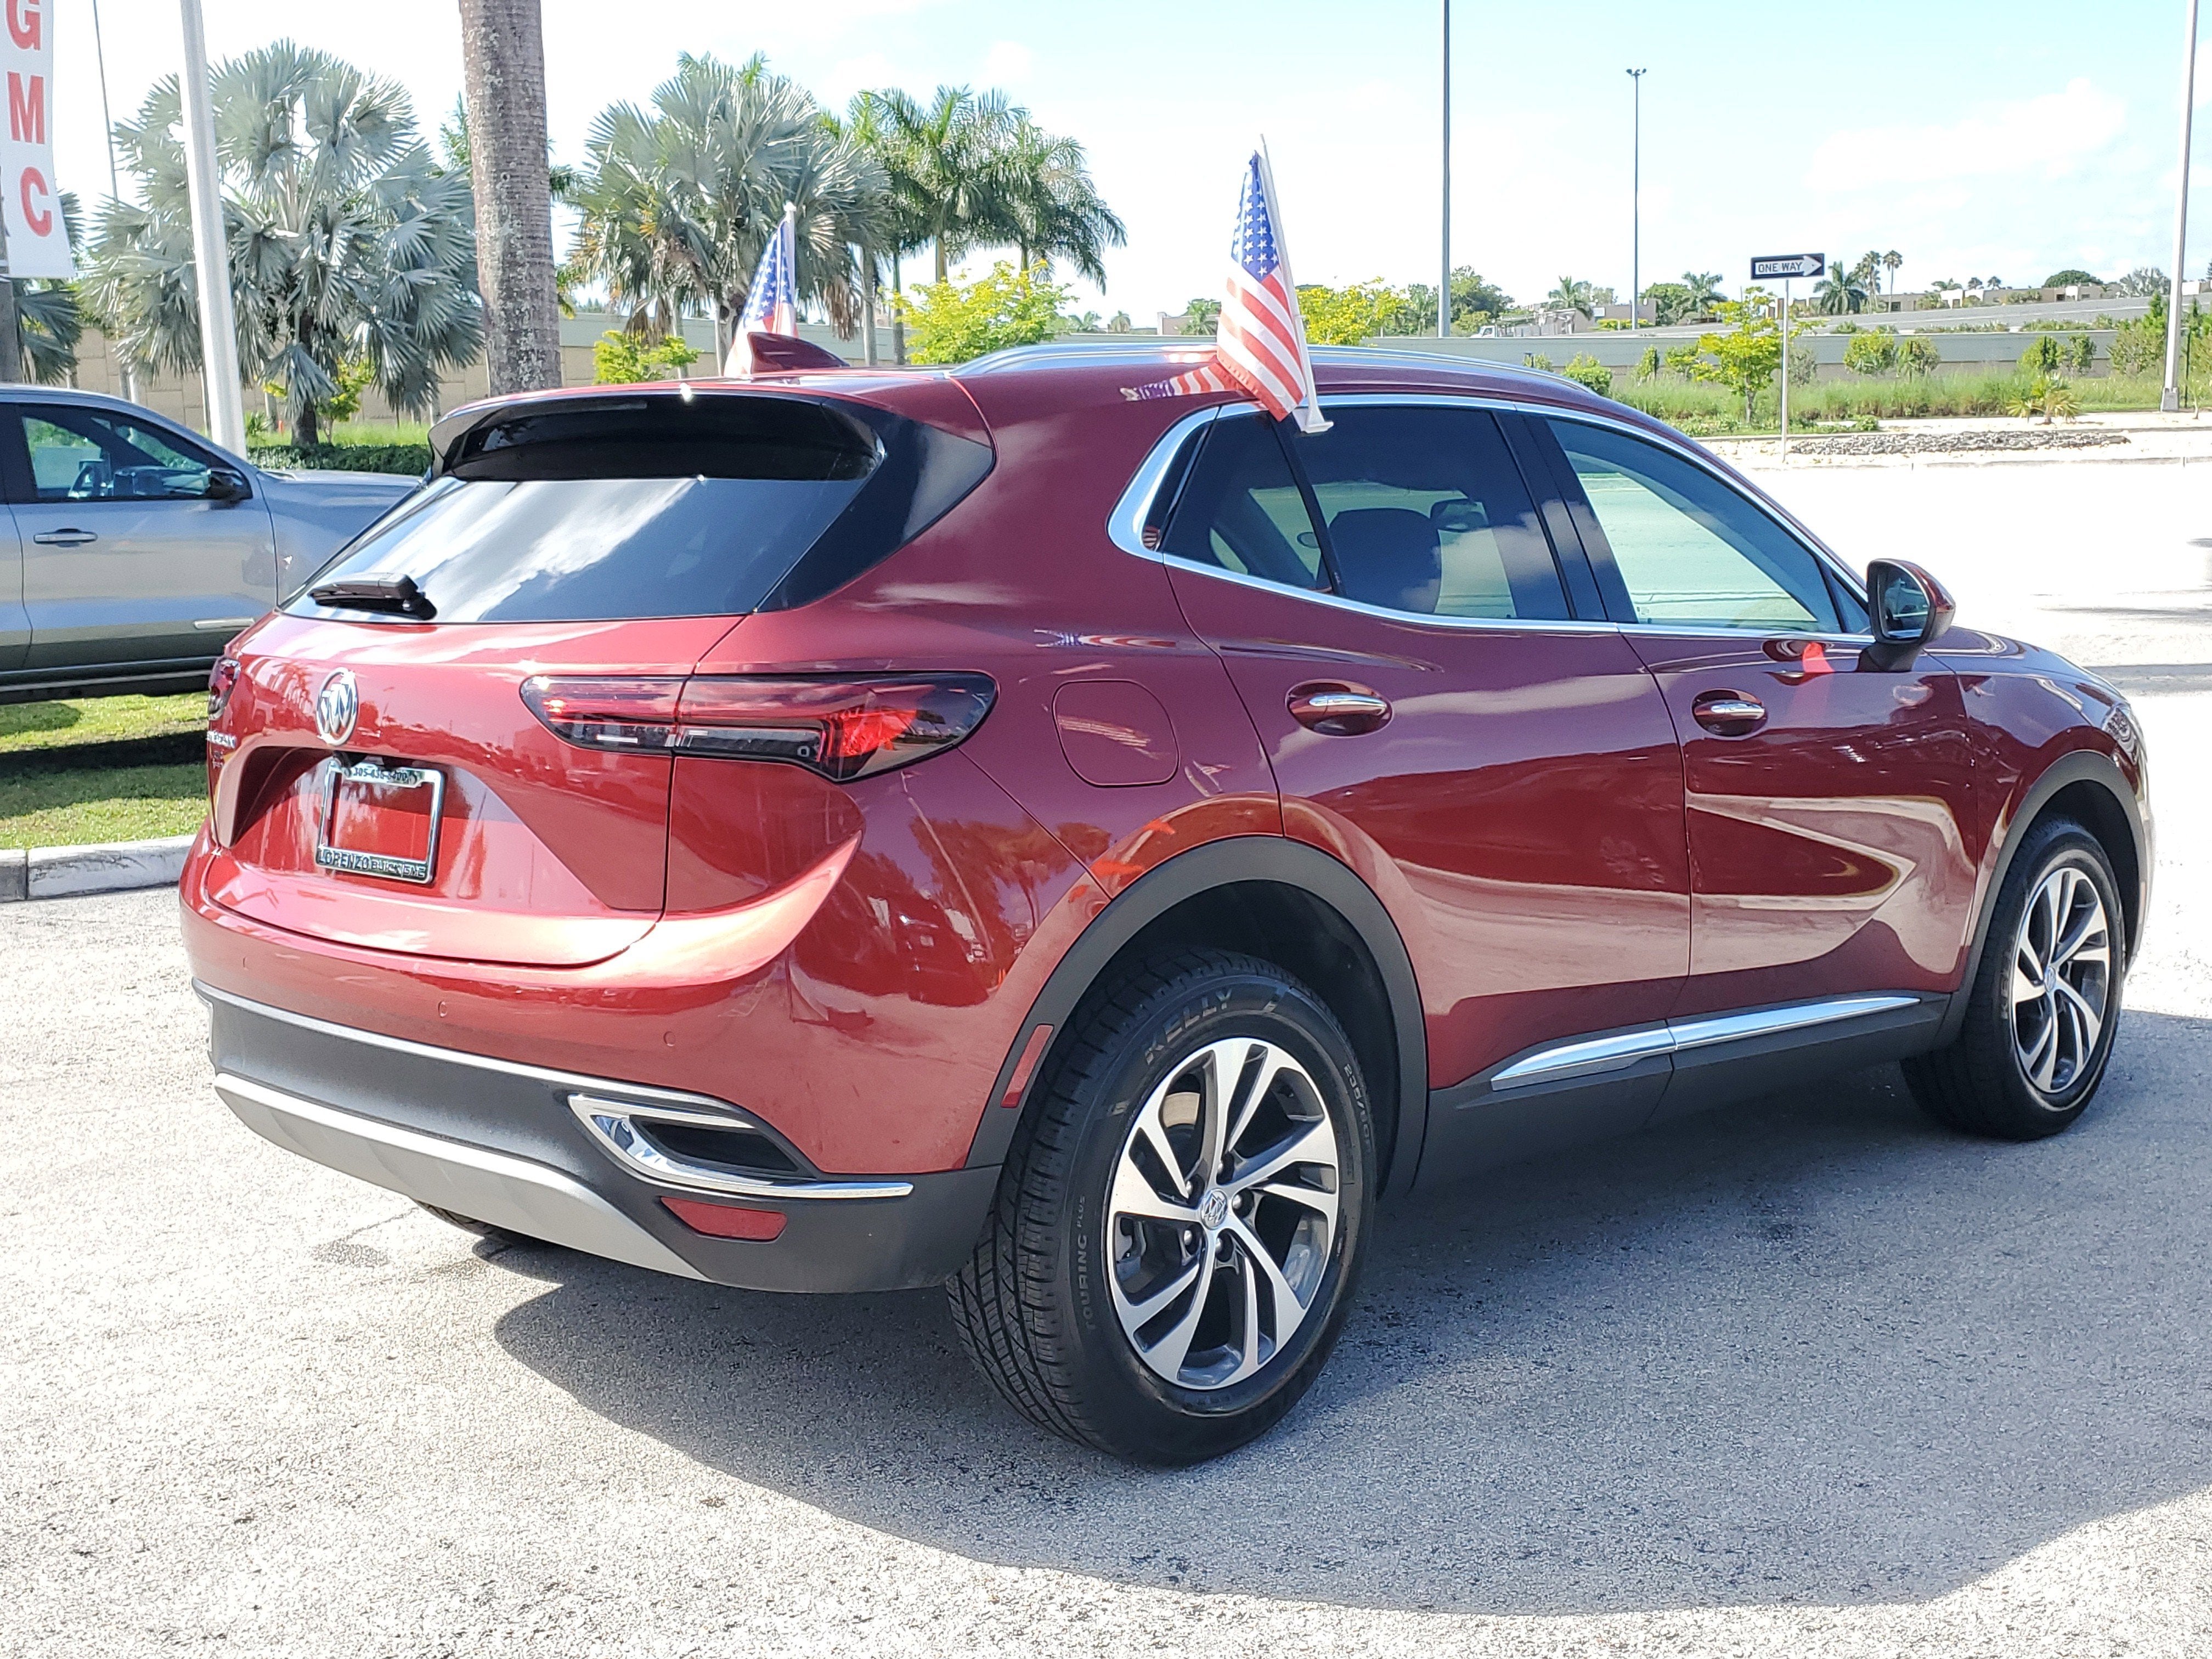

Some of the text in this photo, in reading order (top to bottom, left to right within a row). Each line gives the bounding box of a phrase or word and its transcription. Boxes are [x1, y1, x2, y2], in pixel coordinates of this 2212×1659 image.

[5, 0, 52, 237] GMC
[1758, 262, 1803, 273] ONE WAY
[318, 849, 370, 869] LORENZO
[371, 859, 403, 874] BUICK
[1144, 989, 1232, 1065] KELLY
[1077, 1195, 1096, 1330] TOURING PLUS
